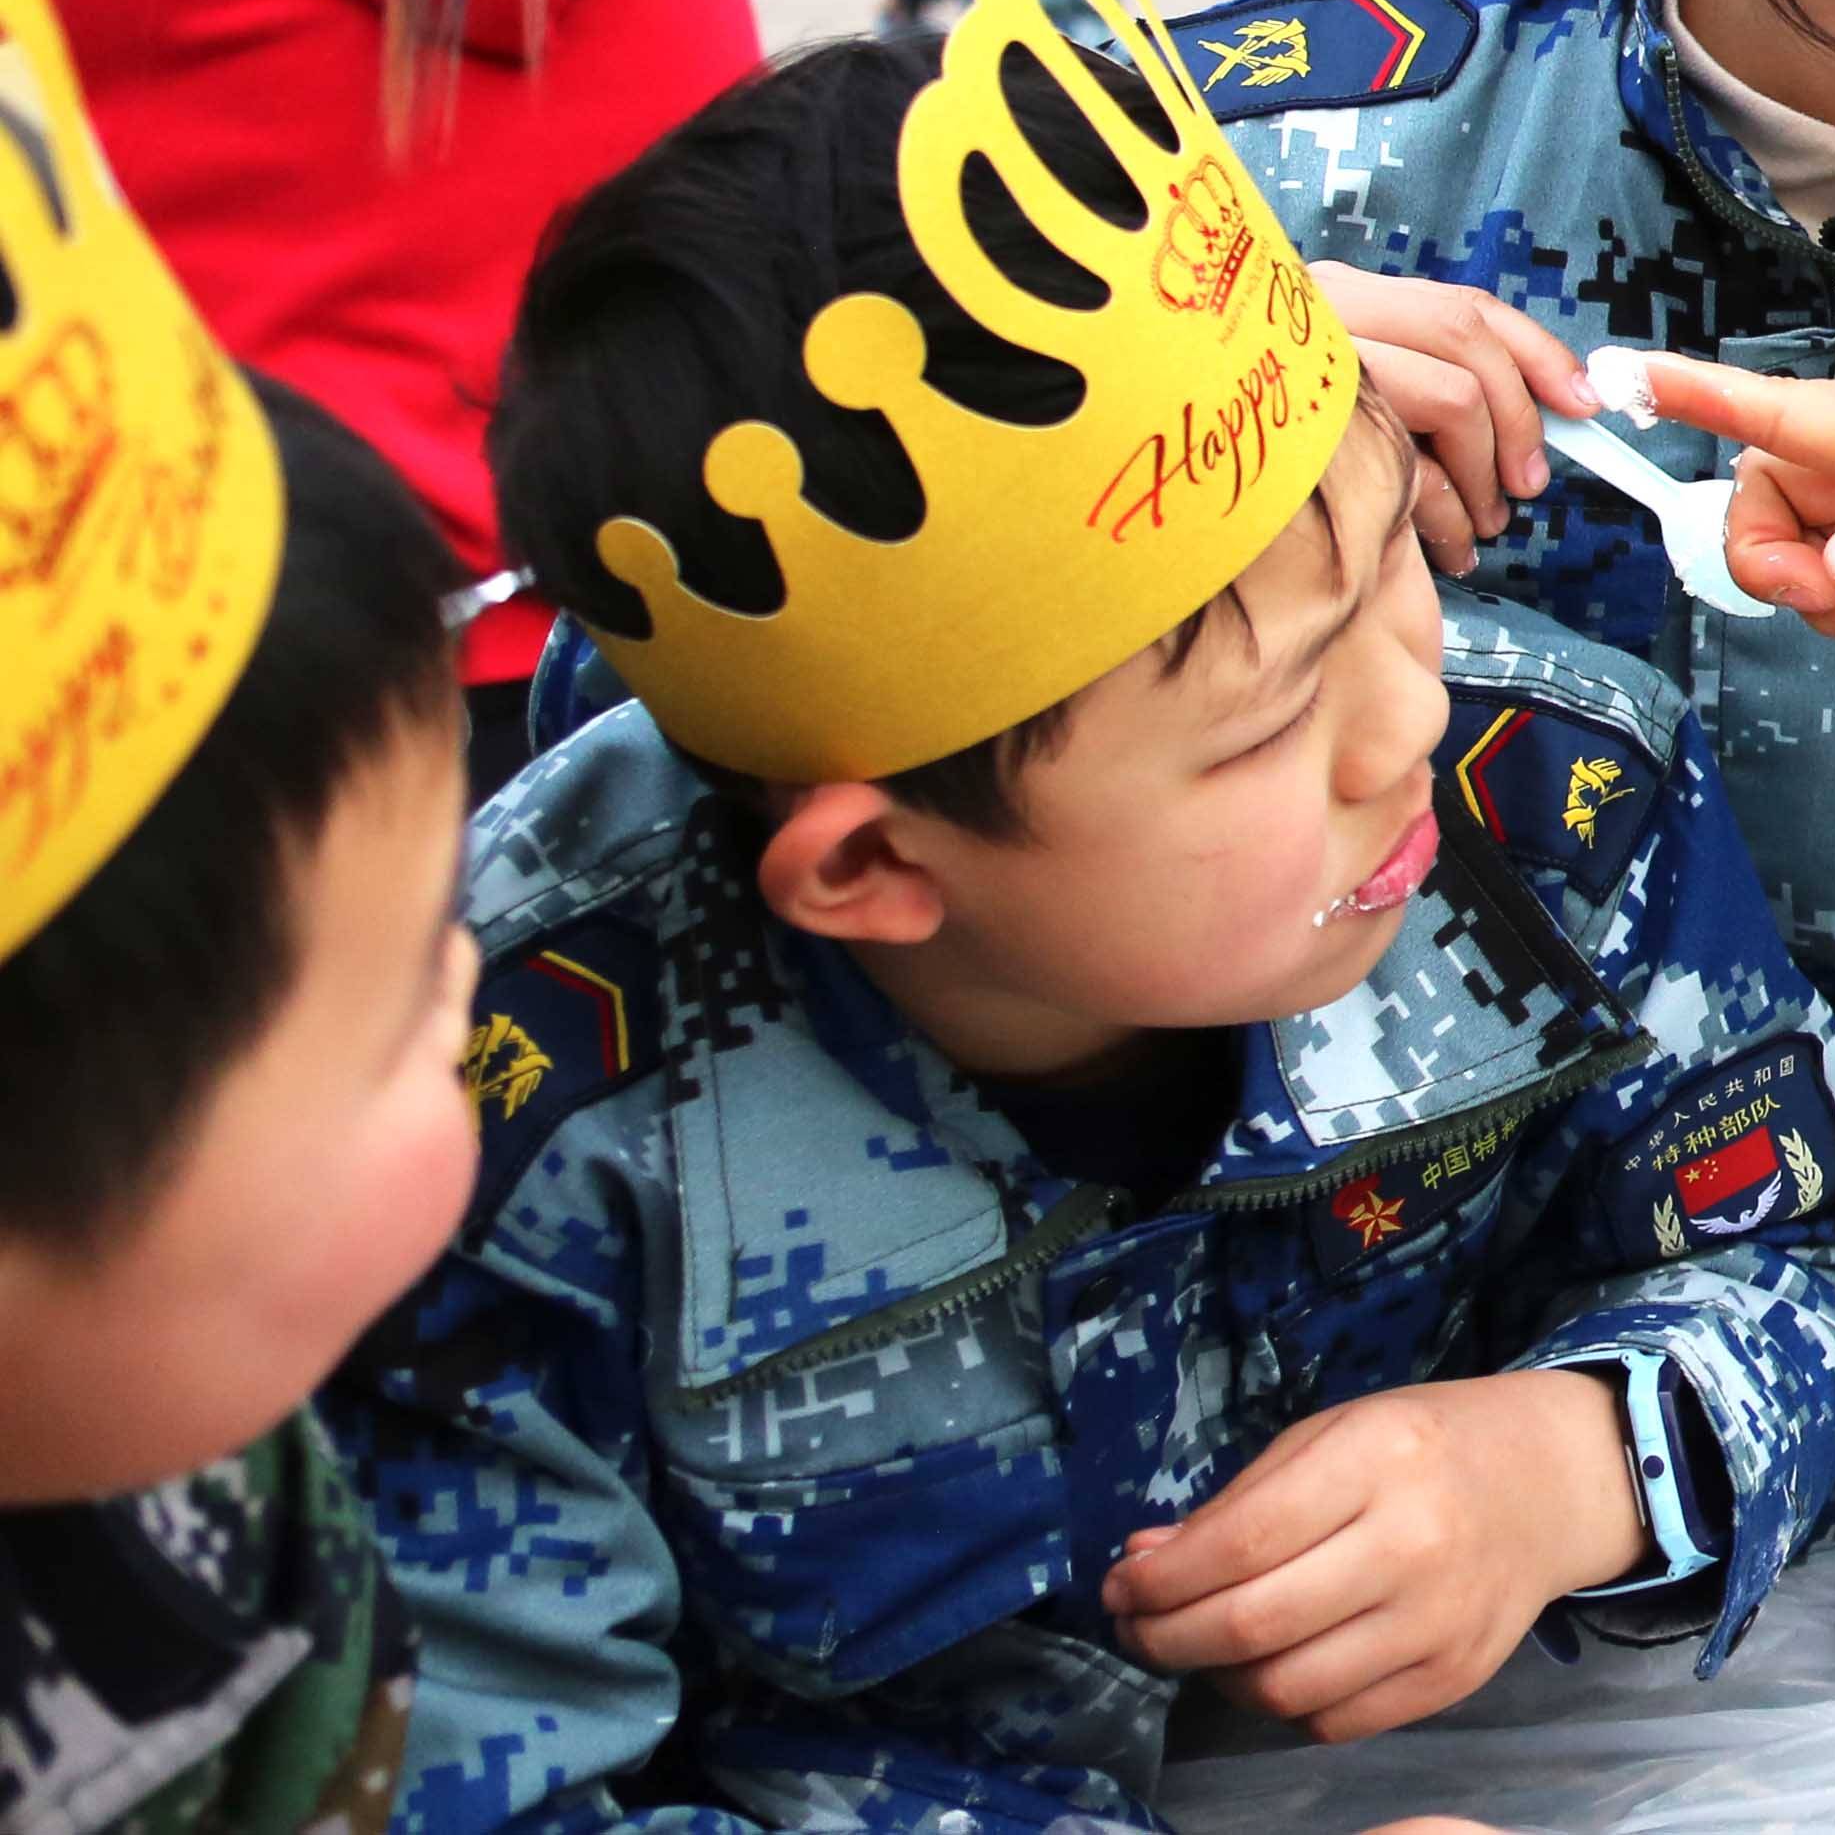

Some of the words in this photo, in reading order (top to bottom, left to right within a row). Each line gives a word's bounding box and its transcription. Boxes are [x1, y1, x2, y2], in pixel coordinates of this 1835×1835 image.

[1086, 347, 1288, 545] Happy
[1624, 1054, 1795, 1172] 中华人民共和国
[1651, 1092, 1782, 1173] 特种部队
